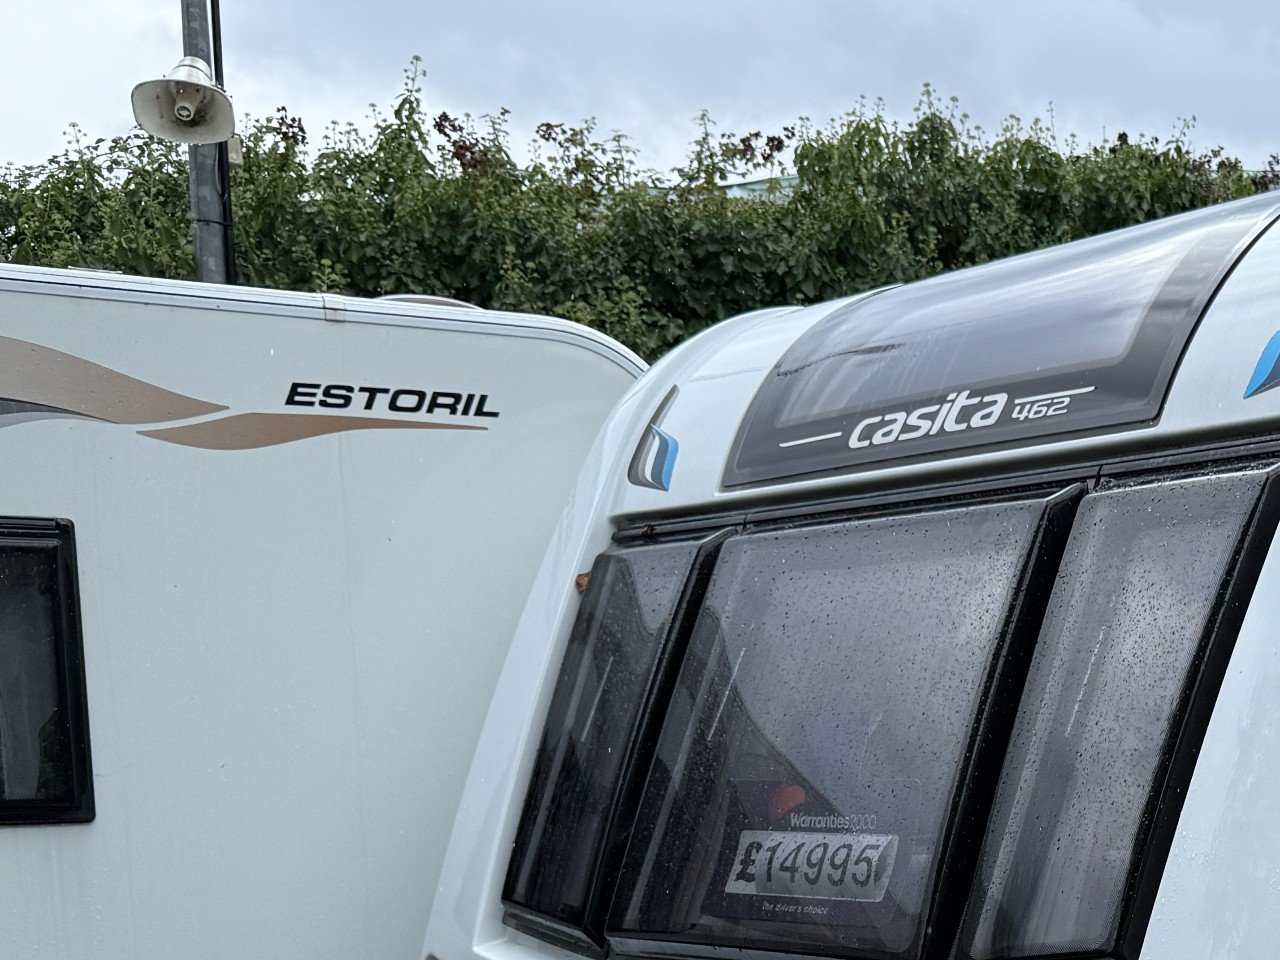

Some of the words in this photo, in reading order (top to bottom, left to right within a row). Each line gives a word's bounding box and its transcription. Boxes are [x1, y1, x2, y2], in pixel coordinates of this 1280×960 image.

[284, 382, 500, 418] ESTORIL
[848, 390, 1008, 449] casita
[1011, 397, 1071, 422] 462
[734, 840, 882, 888] £14995
[803, 904, 829, 915] choice
